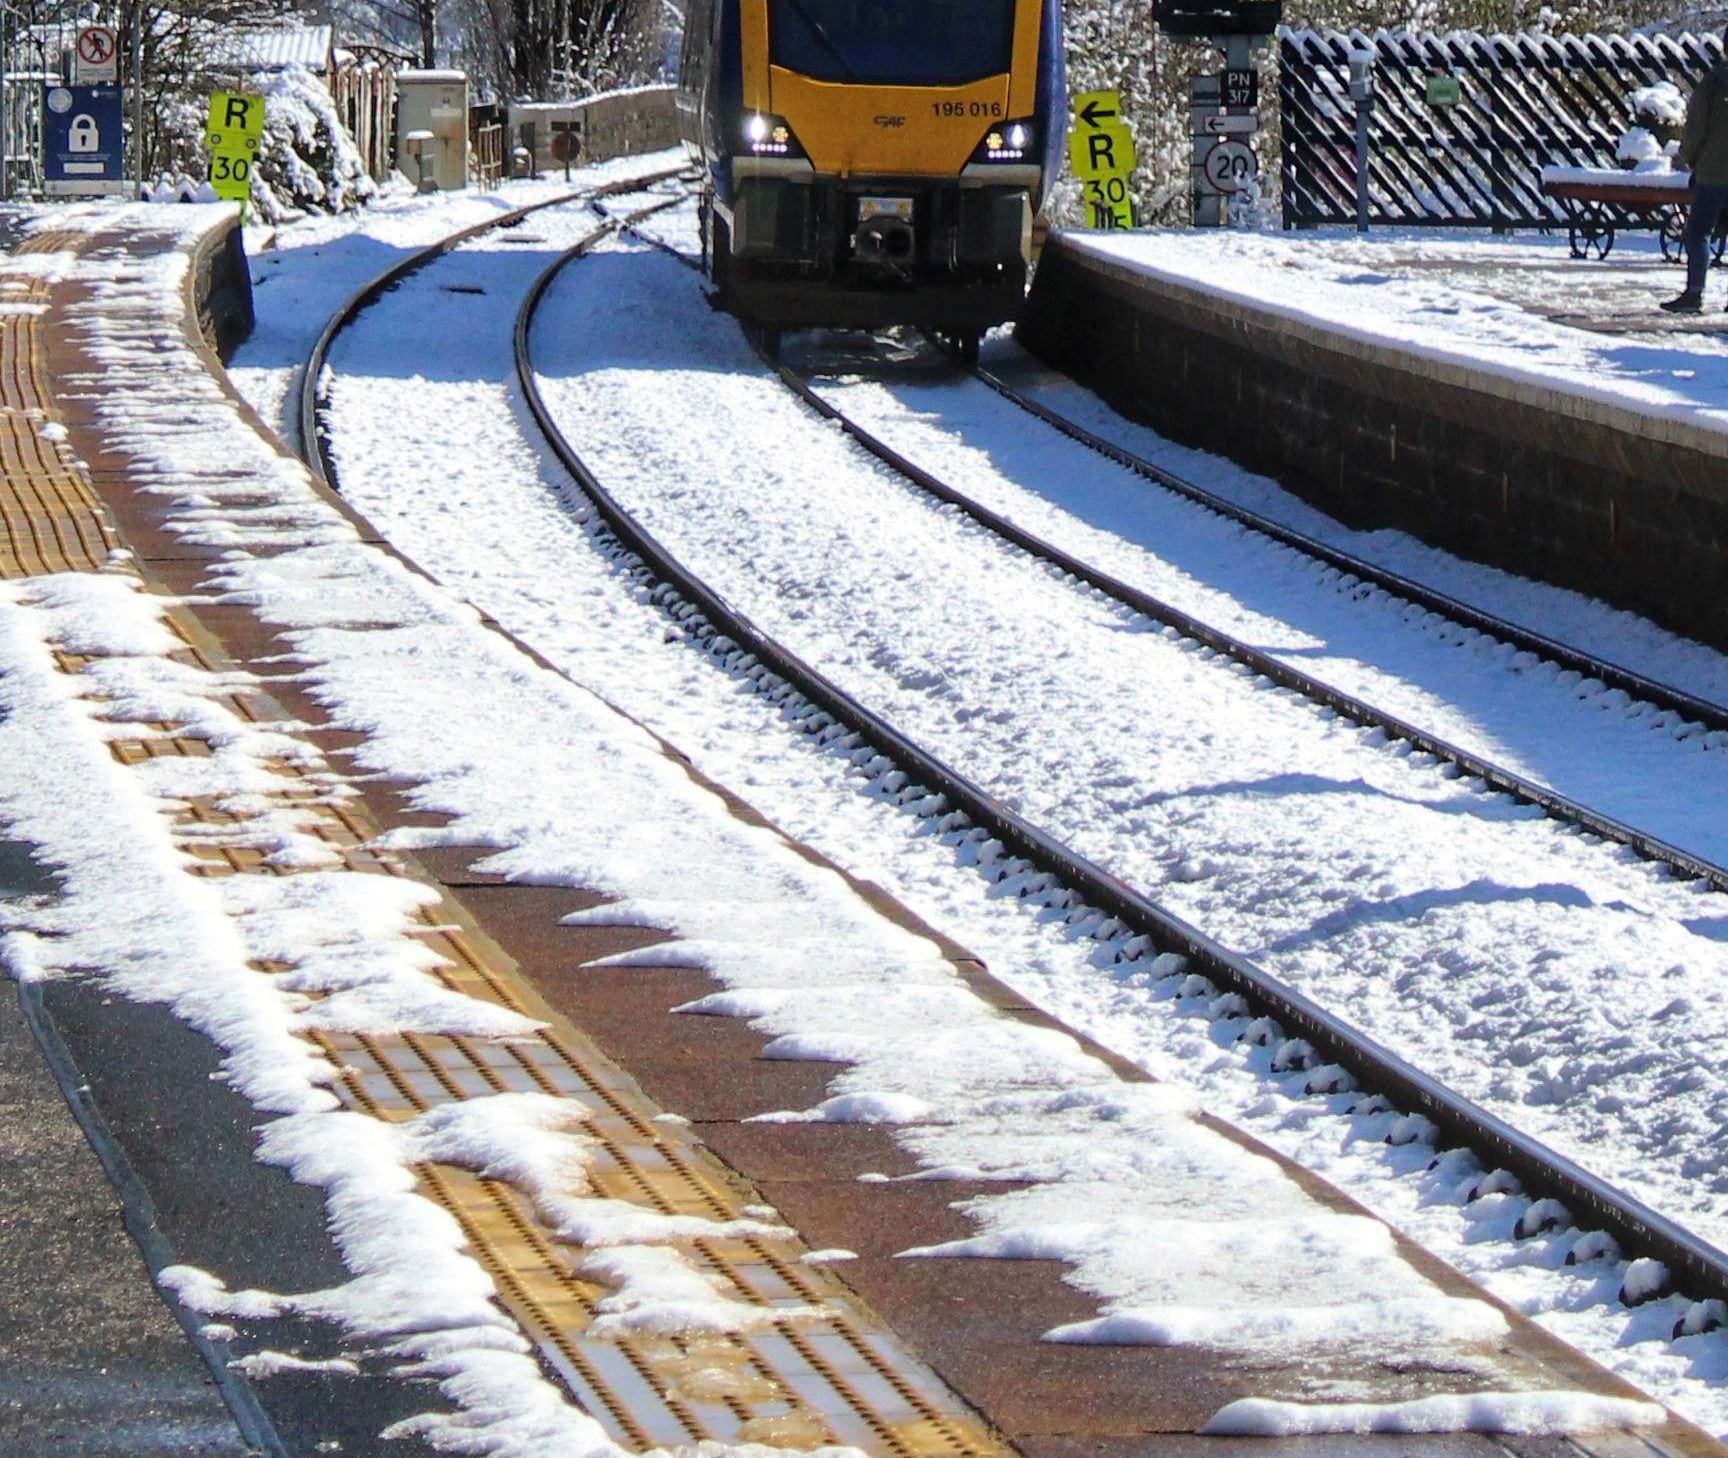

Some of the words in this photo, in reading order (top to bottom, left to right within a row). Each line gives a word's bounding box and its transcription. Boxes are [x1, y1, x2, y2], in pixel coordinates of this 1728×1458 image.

[1228, 73, 1250, 87] PN
[1228, 90, 1250, 104] 317
[225, 98, 249, 129] R
[933, 102, 964, 117] 195
[969, 102, 1002, 117] 016
[1088, 134, 1115, 170] R
[215, 156, 249, 181] 30
[1217, 155, 1248, 179] 20
[1086, 178, 1125, 204] 30
